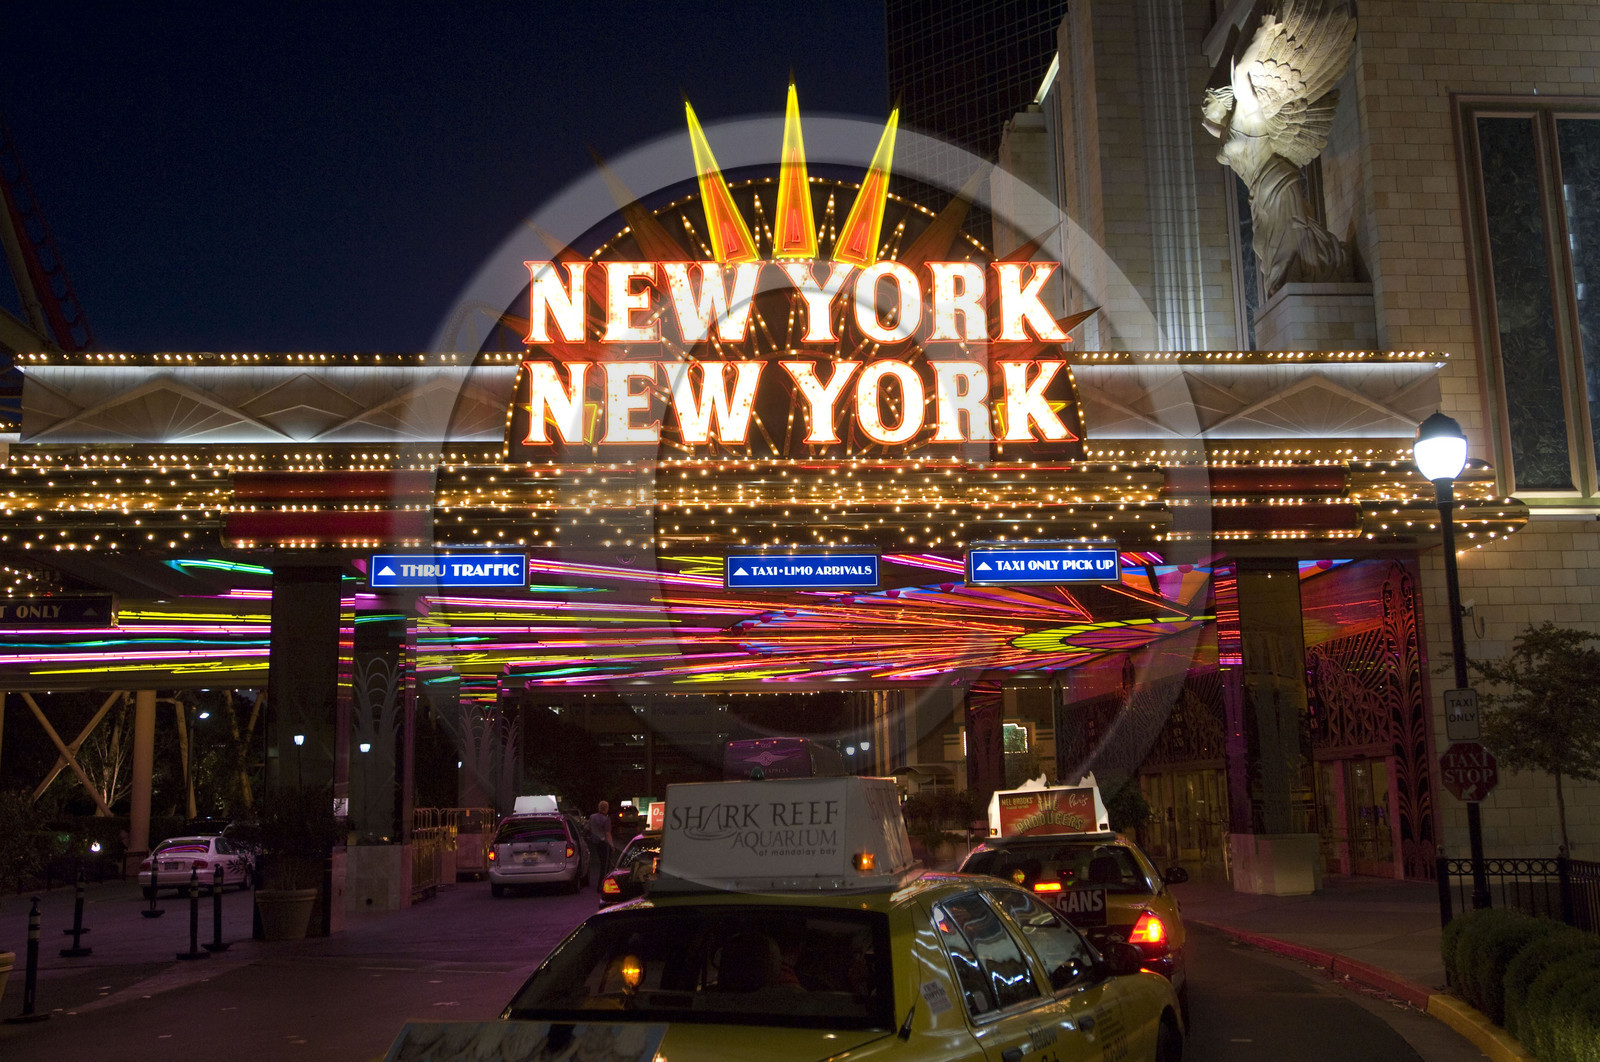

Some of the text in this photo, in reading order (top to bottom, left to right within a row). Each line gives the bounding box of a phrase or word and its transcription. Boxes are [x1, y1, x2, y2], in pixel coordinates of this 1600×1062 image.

[523, 261, 1073, 344] NEW YORK
[522, 360, 1078, 445] NEW YORK
[400, 564, 519, 577] THRU TRAFFIC
[815, 566, 872, 575] ARRIVALS
[995, 560, 1114, 571] TAXI ONLY PICK UP
[16, 605, 62, 618] ONLY
[1450, 698, 1473, 707] TAXI
[1449, 713, 1476, 723] ONLY
[1446, 753, 1488, 768] TAXI
[1444, 768, 1494, 784] STOP
[1037, 793, 1058, 811] THE
[1068, 793, 1088, 808] Paris
[670, 803, 761, 831] SHARK
[769, 801, 838, 827] REEF
[1016, 811, 1084, 834] PRODUCERS
[731, 829, 837, 852] AQUARIUM
[758, 848, 837, 857] at mandalay bay
